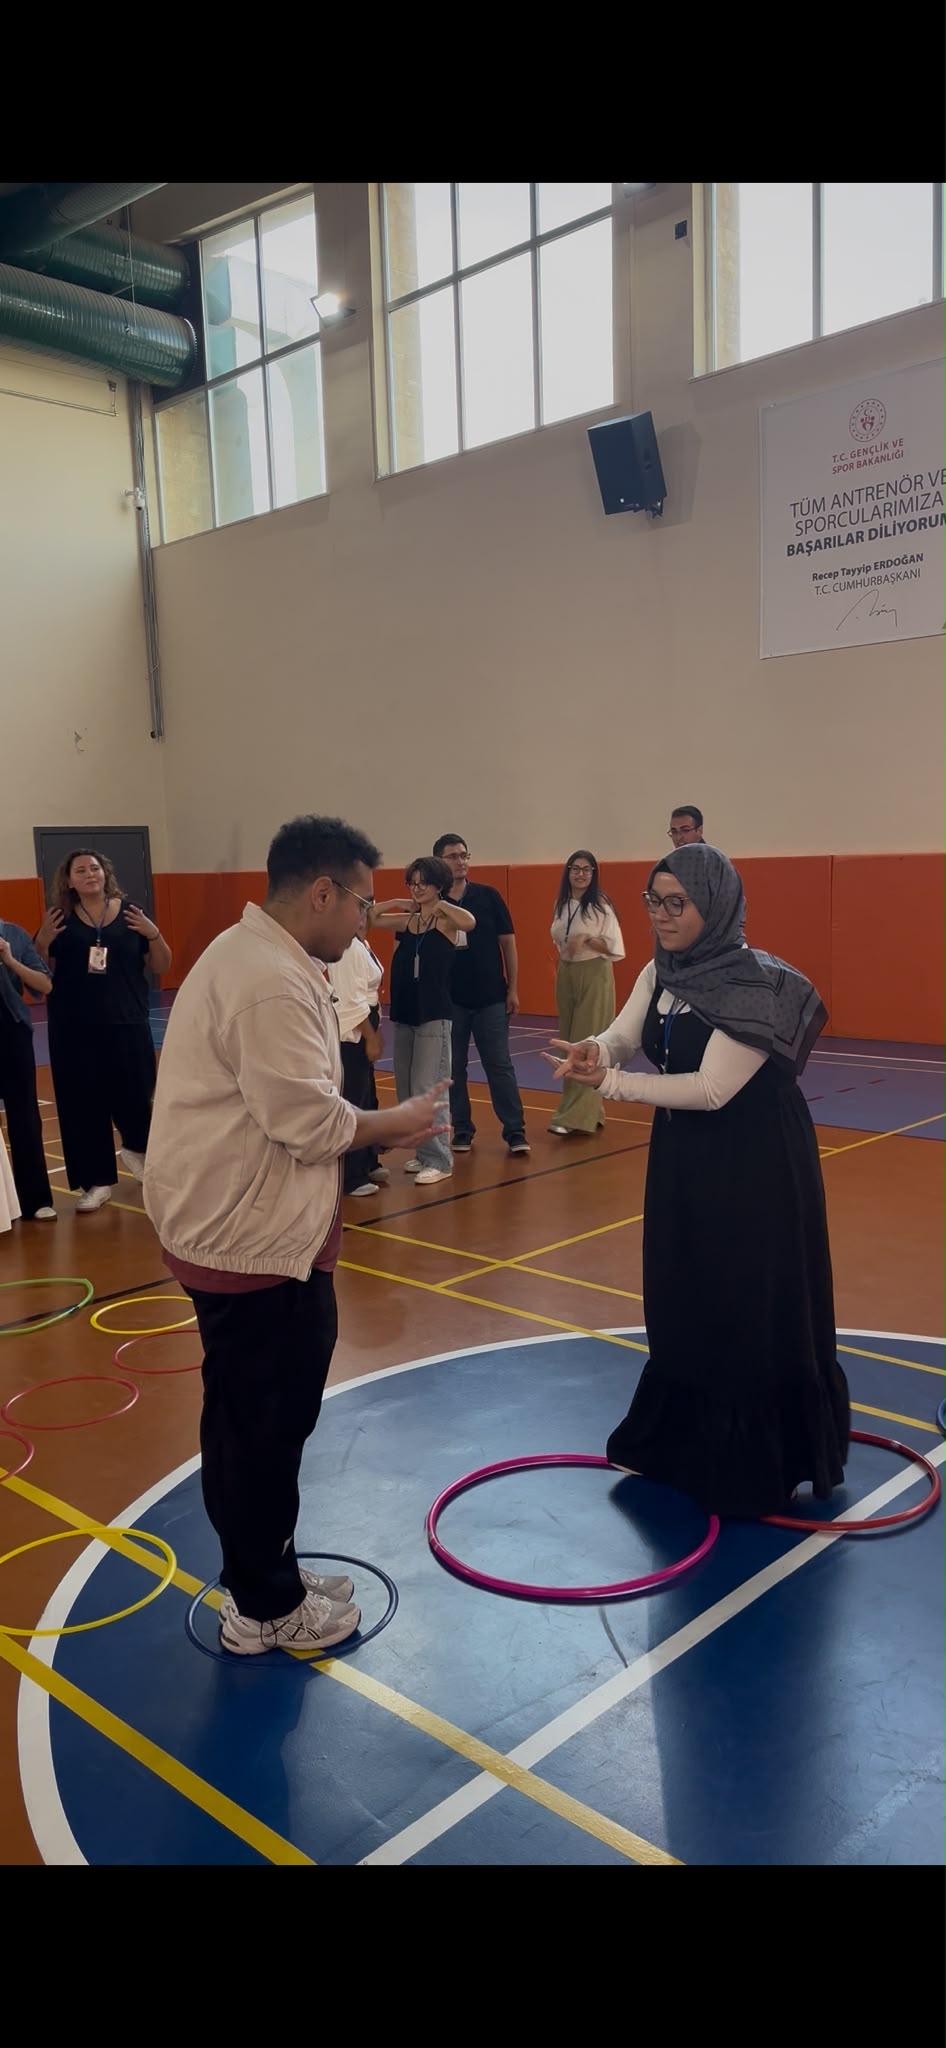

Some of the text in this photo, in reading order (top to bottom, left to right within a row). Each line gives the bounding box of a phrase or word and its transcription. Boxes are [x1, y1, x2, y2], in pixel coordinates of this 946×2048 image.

[832, 450, 904, 475] SPOR BAKANLIĞI
[850, 441, 889, 459] GENÇLİK
[892, 438, 904, 448] VE
[790, 497, 826, 518] TÜM
[831, 474, 924, 510] ANTRENÖR
[795, 490, 944, 537] SPORCULARIMIZA
[786, 530, 865, 557] BAŞARILAR
[812, 553, 924, 582] Recep Tayyip ERDOĞAN
[815, 568, 921, 596] T.C. CUMHURBAŞKANI
